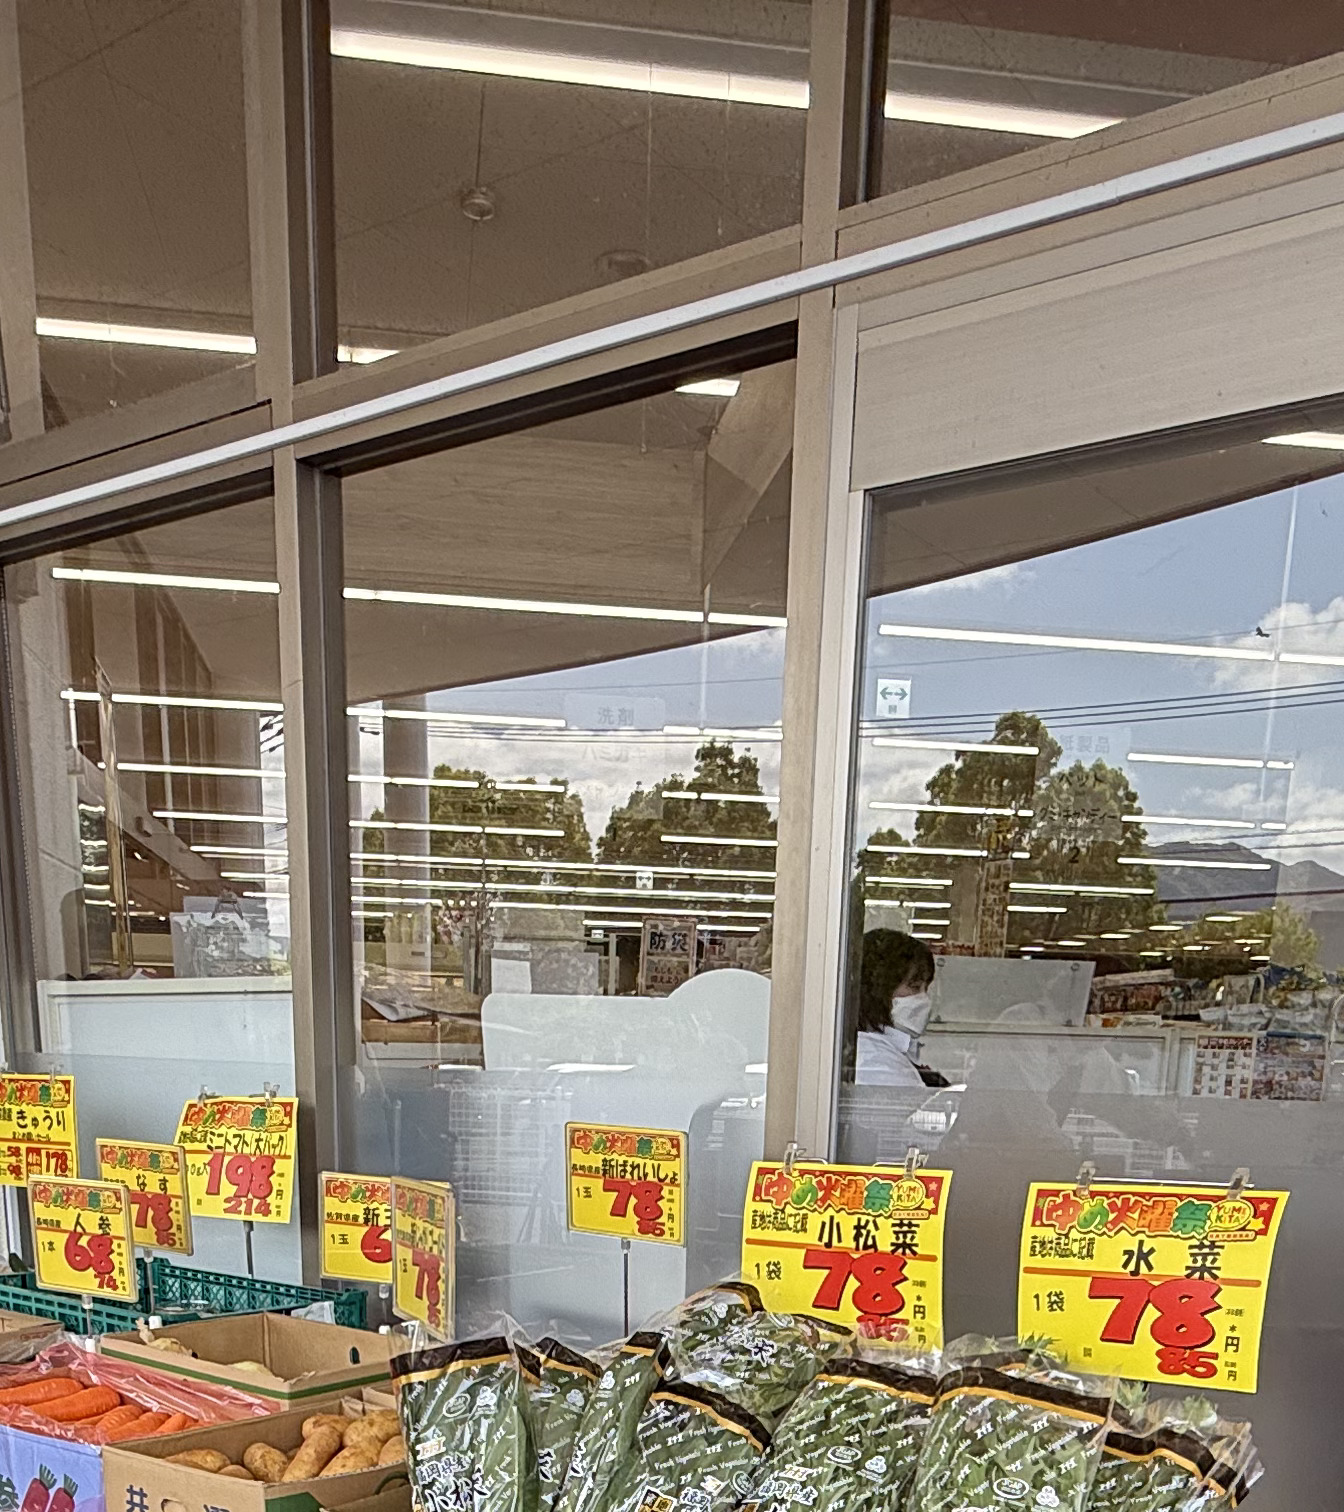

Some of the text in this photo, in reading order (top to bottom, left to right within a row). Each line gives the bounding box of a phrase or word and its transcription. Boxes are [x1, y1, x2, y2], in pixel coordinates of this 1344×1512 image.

[649, 930, 690, 953] 防災
[15, 1109, 67, 1132] きゅうり
[44, 1150, 69, 1175] 178
[601, 1157, 679, 1185] 新ばれいしょ
[135, 1173, 170, 1194] なす
[205, 1151, 276, 1200] 198
[130, 1190, 174, 1232] 78
[222, 1195, 272, 1217] 214
[602, 1178, 665, 1221] 78
[73, 1212, 113, 1236] 人参
[1214, 1214, 1241, 1225] KITA
[817, 1214, 921, 1257] 小松菜
[64, 1231, 116, 1275] 68
[1120, 1239, 1226, 1282] 水菜
[93, 1273, 120, 1292] 74
[753, 1260, 783, 1281] 1袋
[802, 1248, 910, 1317] 78
[1032, 1290, 1067, 1313] 1袋
[1087, 1275, 1224, 1350] 78
[1223, 1334, 1241, 1354] 円
[1155, 1346, 1220, 1379] 85
